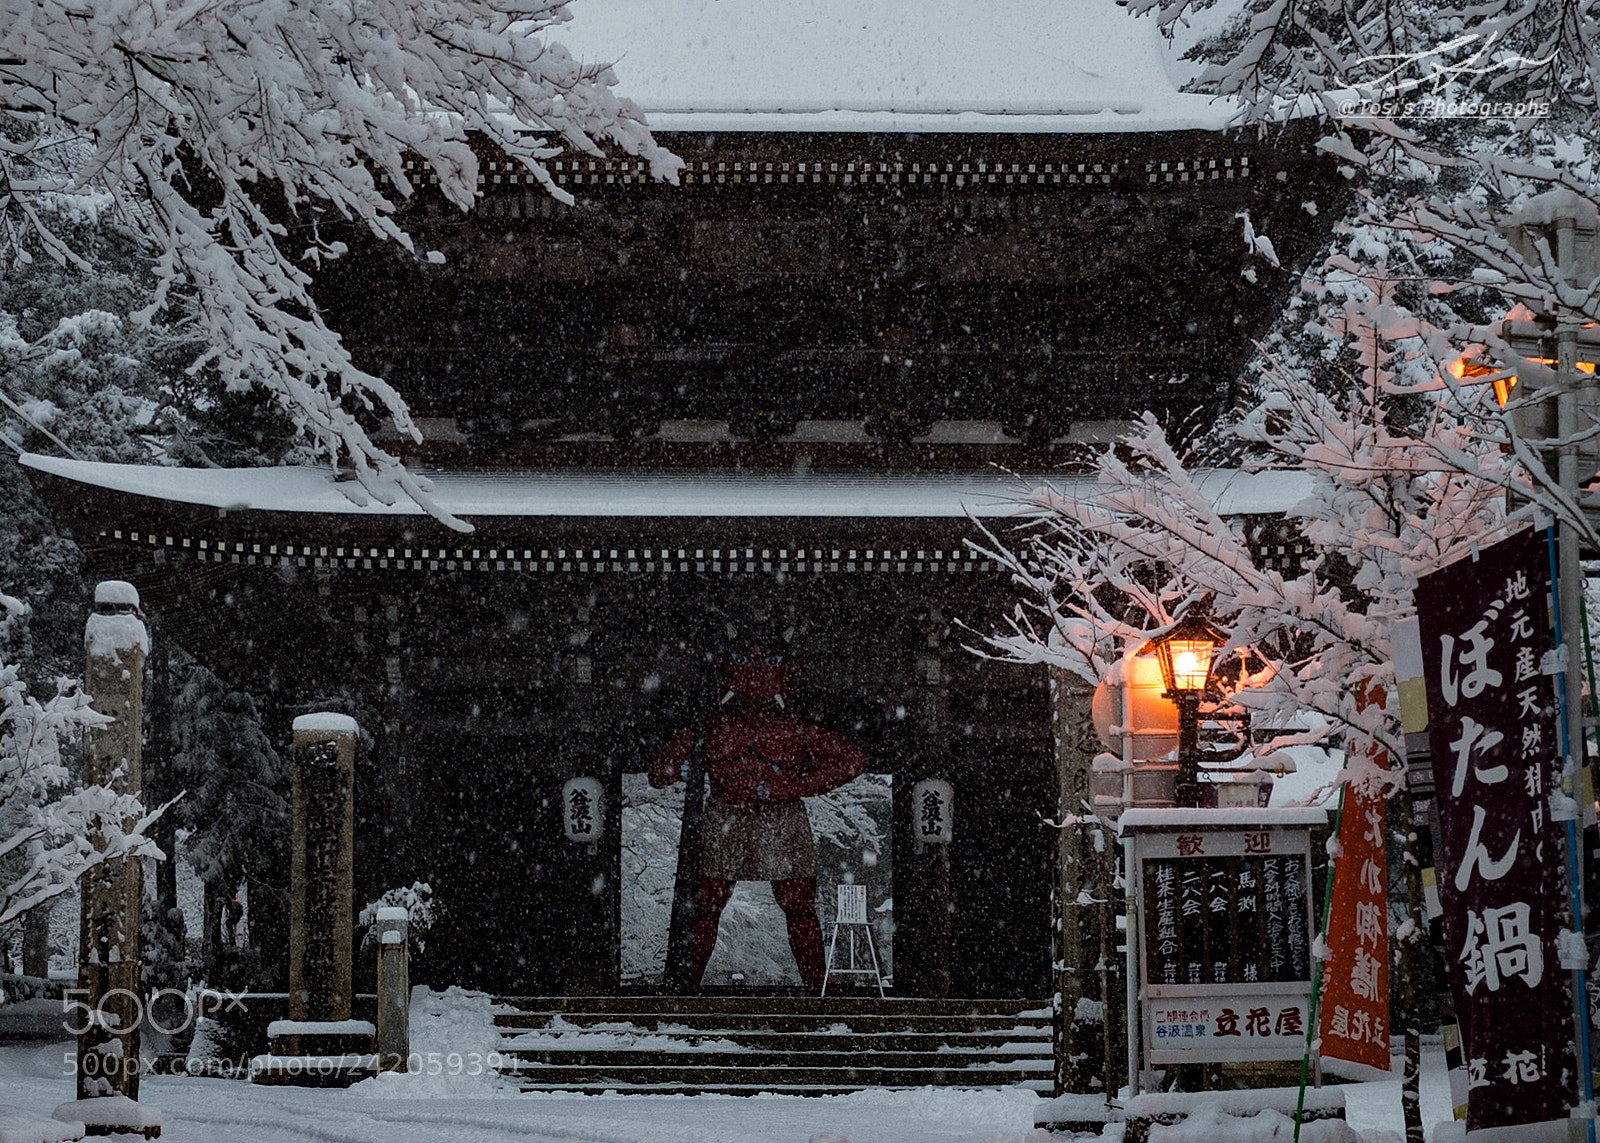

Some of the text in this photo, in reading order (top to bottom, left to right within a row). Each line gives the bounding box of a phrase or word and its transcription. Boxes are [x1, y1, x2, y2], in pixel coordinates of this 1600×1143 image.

[569, 788, 593, 834] 谷汲山
[921, 789, 944, 837] 谷汲山
[1440, 599, 1544, 996] ぼたん鍋
[1155, 1024, 1206, 1038] 谷汲温泉
[1213, 1006, 1305, 1037] 立花屋
[1468, 1044, 1547, 1090] 立花
